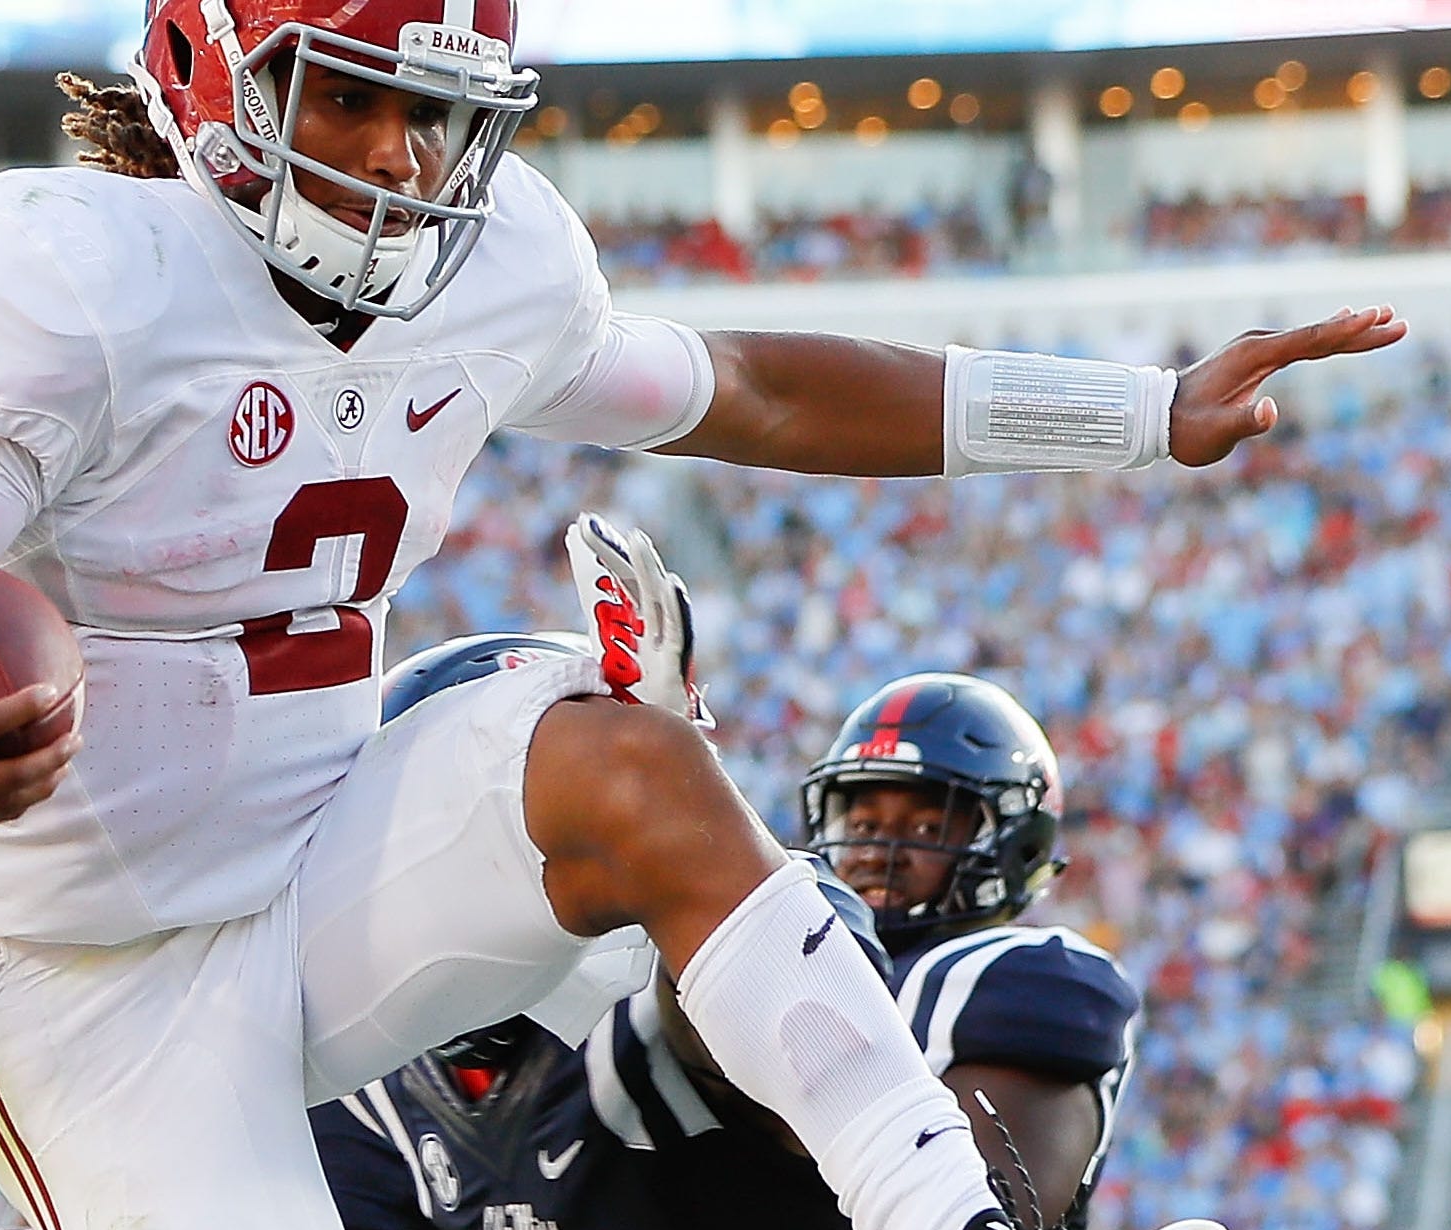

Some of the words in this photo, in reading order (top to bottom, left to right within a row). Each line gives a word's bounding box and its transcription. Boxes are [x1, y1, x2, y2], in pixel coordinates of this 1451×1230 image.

[431, 30, 482, 56] BAMA
[233, 384, 290, 462] SEC
[237, 476, 410, 697] 2
